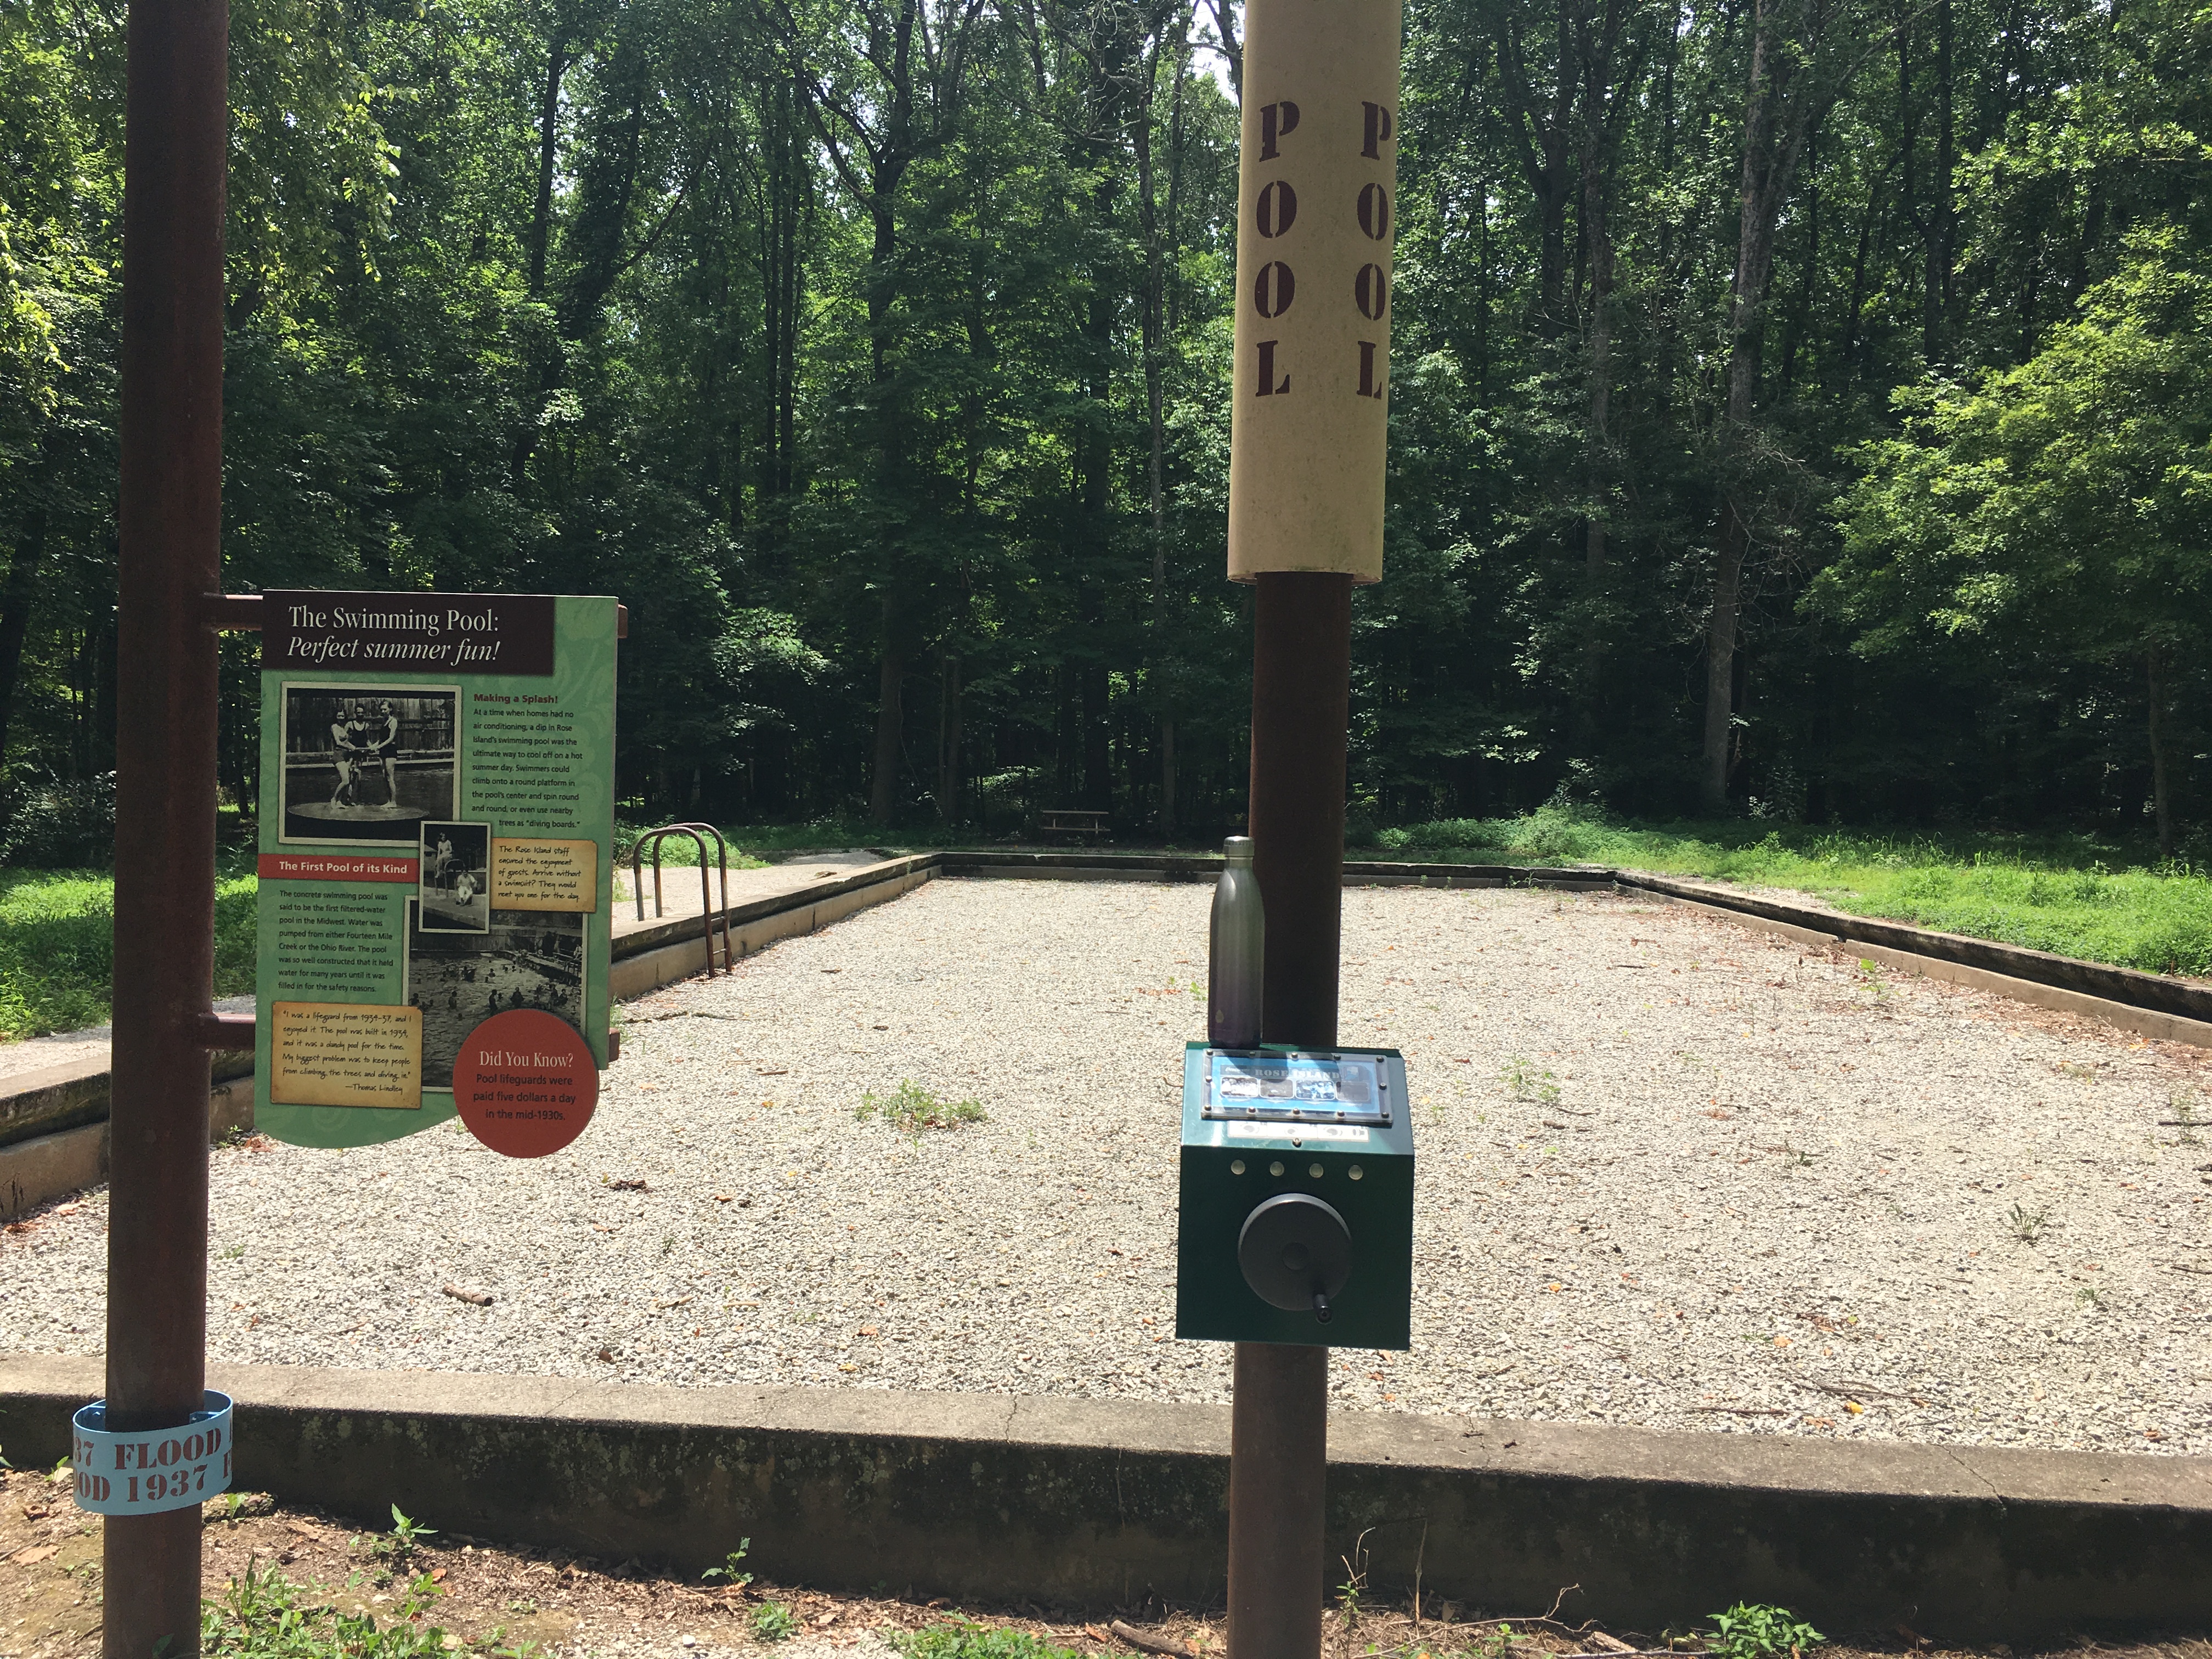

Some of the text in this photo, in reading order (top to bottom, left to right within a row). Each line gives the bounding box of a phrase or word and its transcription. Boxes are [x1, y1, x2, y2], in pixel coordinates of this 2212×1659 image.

[1254, 100, 1300, 397] POOL
[1355, 100, 1392, 400] POOL
[289, 605, 498, 637] The Swimming Pool:
[287, 635, 500, 667] Perfect summer fun!
[473, 693, 511, 704] Making
[522, 695, 558, 705] Splash!
[489, 708, 504, 716] time
[526, 709, 549, 718] homes
[550, 709, 563, 718] had
[483, 723, 528, 732] conditioning,
[535, 723, 547, 732] dip
[498, 736, 533, 746] swimming
[534, 737, 550, 746] pool
[500, 764, 514, 773] day.
[515, 764, 550, 772] Swimmers
[537, 778, 567, 787] platform
[472, 790, 483, 798] the
[485, 791, 505, 799] pool's
[486, 805, 509, 813] round,
[550, 807, 574, 816] nearby
[526, 820, 550, 829] "diving
[515, 845, 532, 854] Rose
[554, 847, 570, 857] staff
[279, 861, 407, 873] The First Pool of its Kind
[540, 859, 573, 869] enjoyment
[504, 879, 537, 887] swimsuit?
[538, 880, 556, 891] They
[323, 891, 357, 901] swimming
[358, 893, 374, 901] pool
[325, 904, 338, 912] first
[340, 905, 386, 913] filtered-water
[279, 916, 295, 924] pool
[317, 917, 346, 926] Midwest.
[279, 930, 307, 939] pumped
[371, 946, 387, 954] pool
[329, 983, 348, 993] safety
[479, 1050, 573, 1068] Did You Know?
[283, 1066, 297, 1076] from
[300, 1067, 328, 1080] climbing
[343, 1069, 362, 1077] trees
[377, 1070, 400, 1082] diving
[476, 1073, 497, 1084] Pool
[500, 1074, 547, 1086] lifeguards
[1293, 1070, 1340, 1079] ISLAND
[379, 1084, 403, 1096] Lindley
[473, 1091, 494, 1103] paid
[496, 1091, 514, 1102] five
[516, 1092, 548, 1102] dollars
[558, 1093, 576, 1105] day
[486, 1109, 566, 1121] in the mid-1930s.
[114, 1427, 221, 1470] FLOOD
[127, 1464, 208, 1502] 1937
